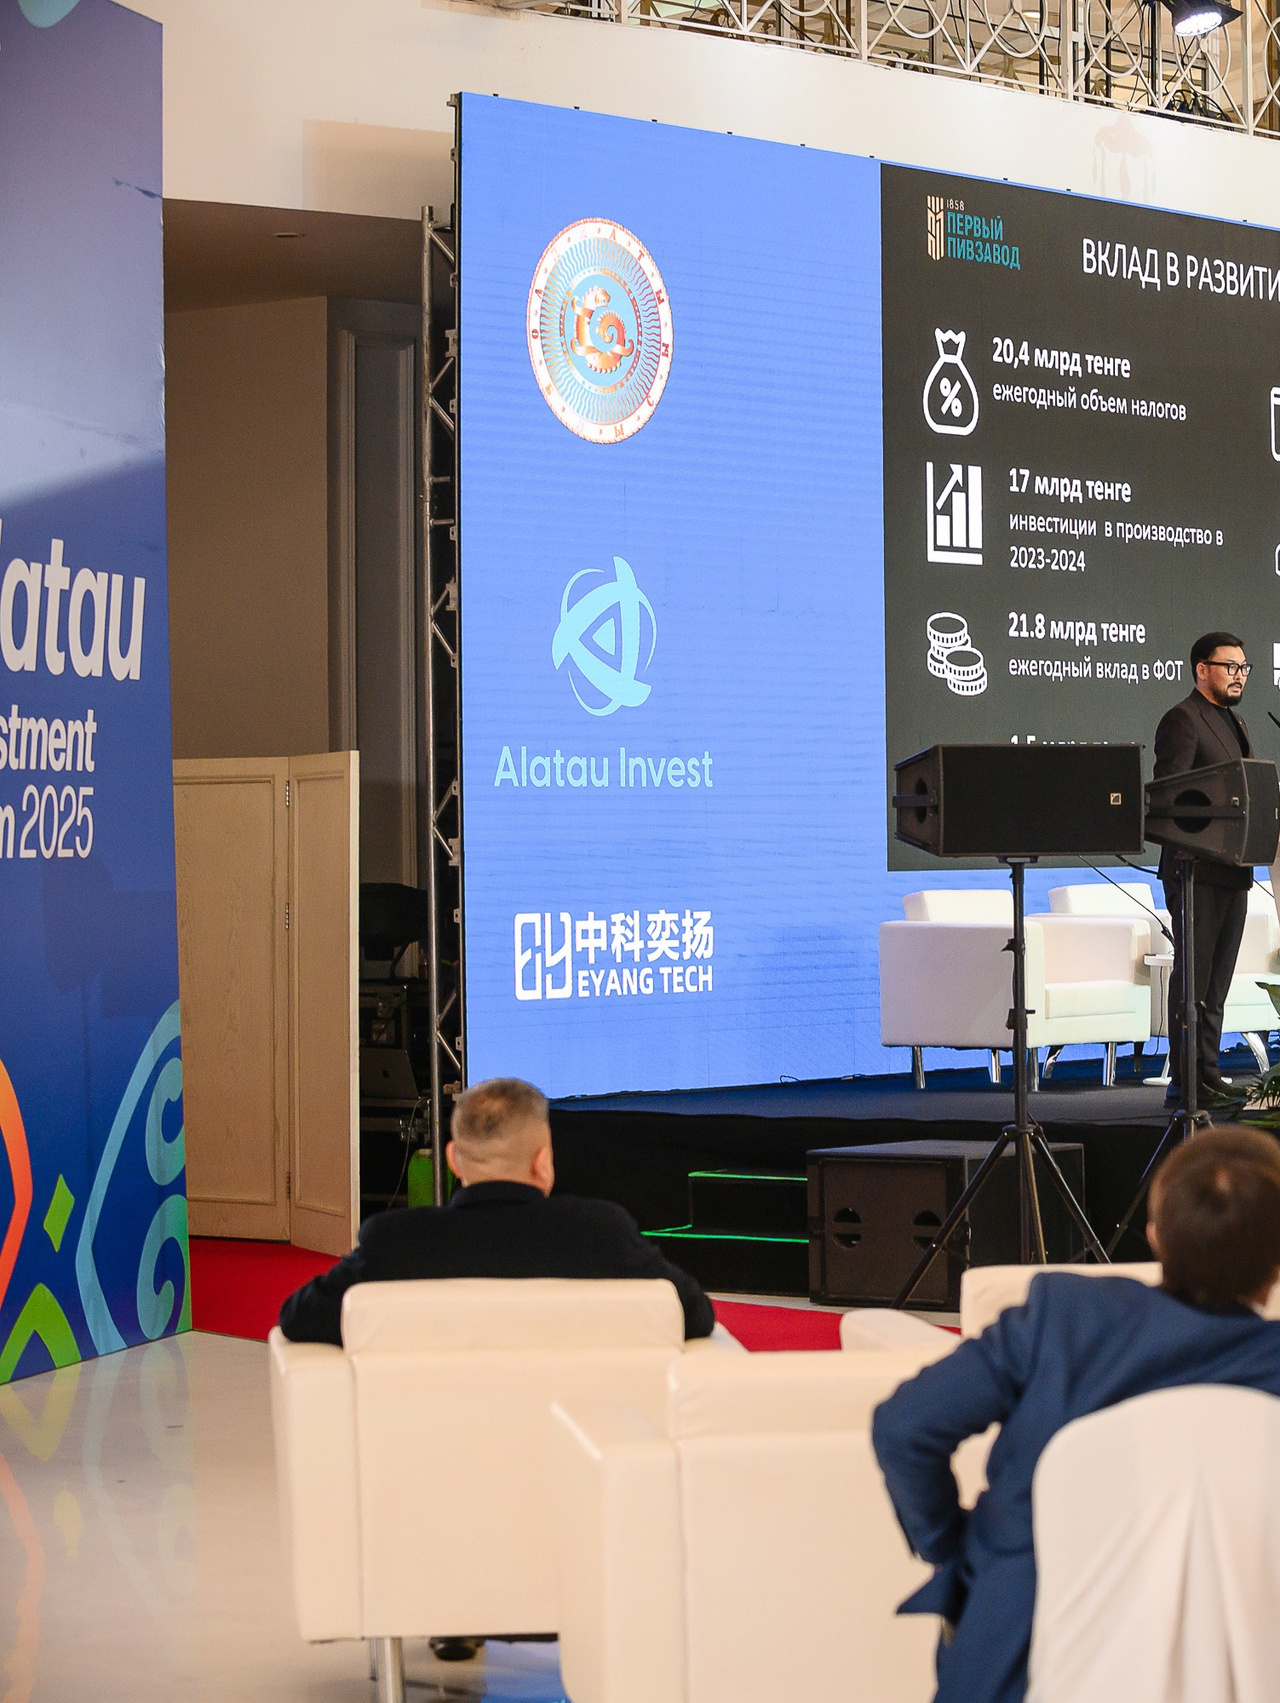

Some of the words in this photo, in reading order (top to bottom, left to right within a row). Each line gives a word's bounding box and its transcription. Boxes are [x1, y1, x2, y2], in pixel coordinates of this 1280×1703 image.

[946, 198, 965, 211] 1858
[947, 211, 1003, 241] ПЕРВЫЙ
[947, 236, 1021, 270] ПИВЗАВОД
[1083, 238, 1161, 291] ВКЛАД
[1167, 252, 1180, 286] В
[993, 337, 1030, 369] 20,4
[1034, 348, 1082, 378] млрд
[1085, 354, 1130, 378] тенге
[993, 383, 1076, 410] ежегодный
[1081, 389, 1127, 414] объем
[1132, 399, 1186, 421] налогов
[1010, 468, 1030, 493] 17
[1035, 476, 1083, 503] млрд
[1086, 480, 1131, 502] тенге
[1010, 514, 1096, 540] инвестиции
[1105, 521, 1112, 537] в
[1116, 522, 1212, 548] производство
[1216, 530, 1223, 545] в
[1010, 546, 1086, 572] 2023-2024
[1009, 612, 1045, 639] 21.8
[1050, 620, 1097, 647] млрд
[1101, 623, 1145, 644] тенге
[1009, 656, 1092, 682] ежегодный
[1096, 662, 1138, 684] вклад
[1142, 664, 1150, 680] в
[1153, 659, 1183, 681] ФОТ
[494, 745, 609, 788] Alatau
[619, 746, 714, 788] Invest
[19, 784, 94, 859] 2025
[575, 909, 714, 964] 中科奕扬
[577, 967, 654, 998] EYANG
[659, 965, 714, 993] TECH
